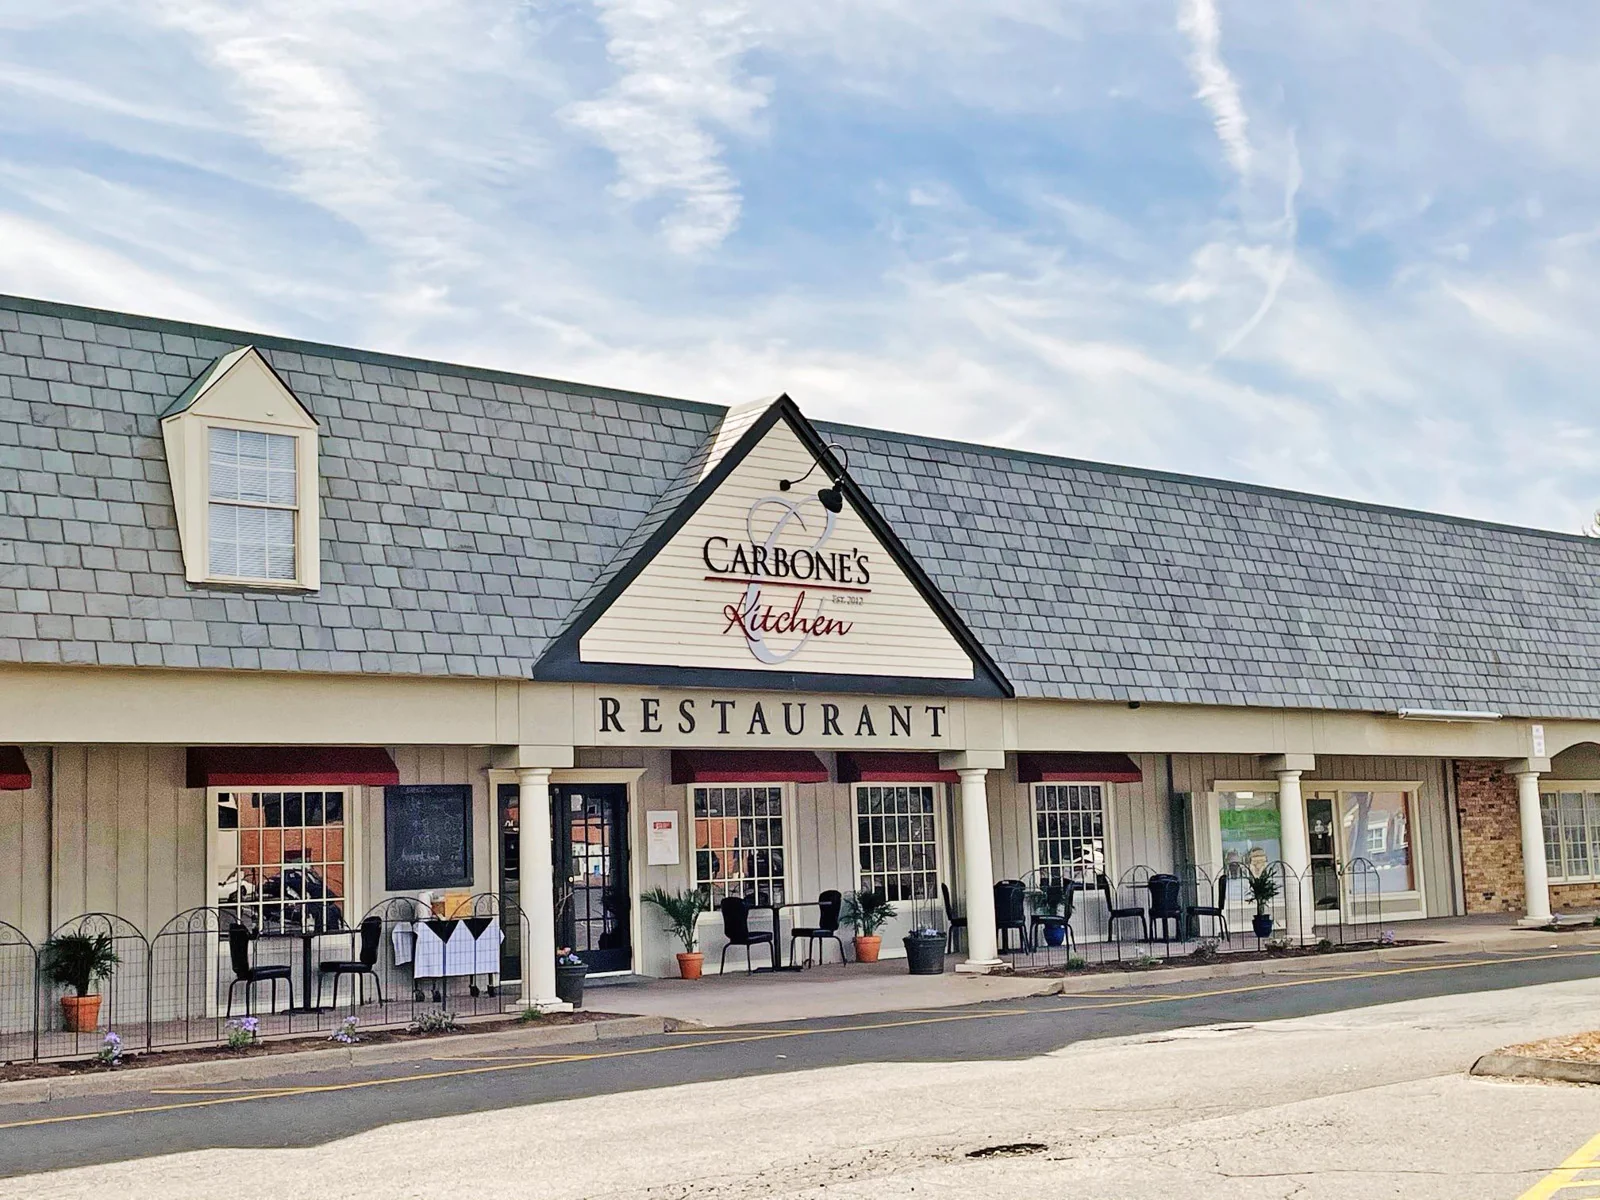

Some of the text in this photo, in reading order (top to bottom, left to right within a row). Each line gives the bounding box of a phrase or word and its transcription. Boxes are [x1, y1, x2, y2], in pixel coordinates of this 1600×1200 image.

[703, 536, 870, 585] CARBONE'S
[722, 590, 854, 642] Kitchen
[598, 697, 946, 738] RESTAURANT
